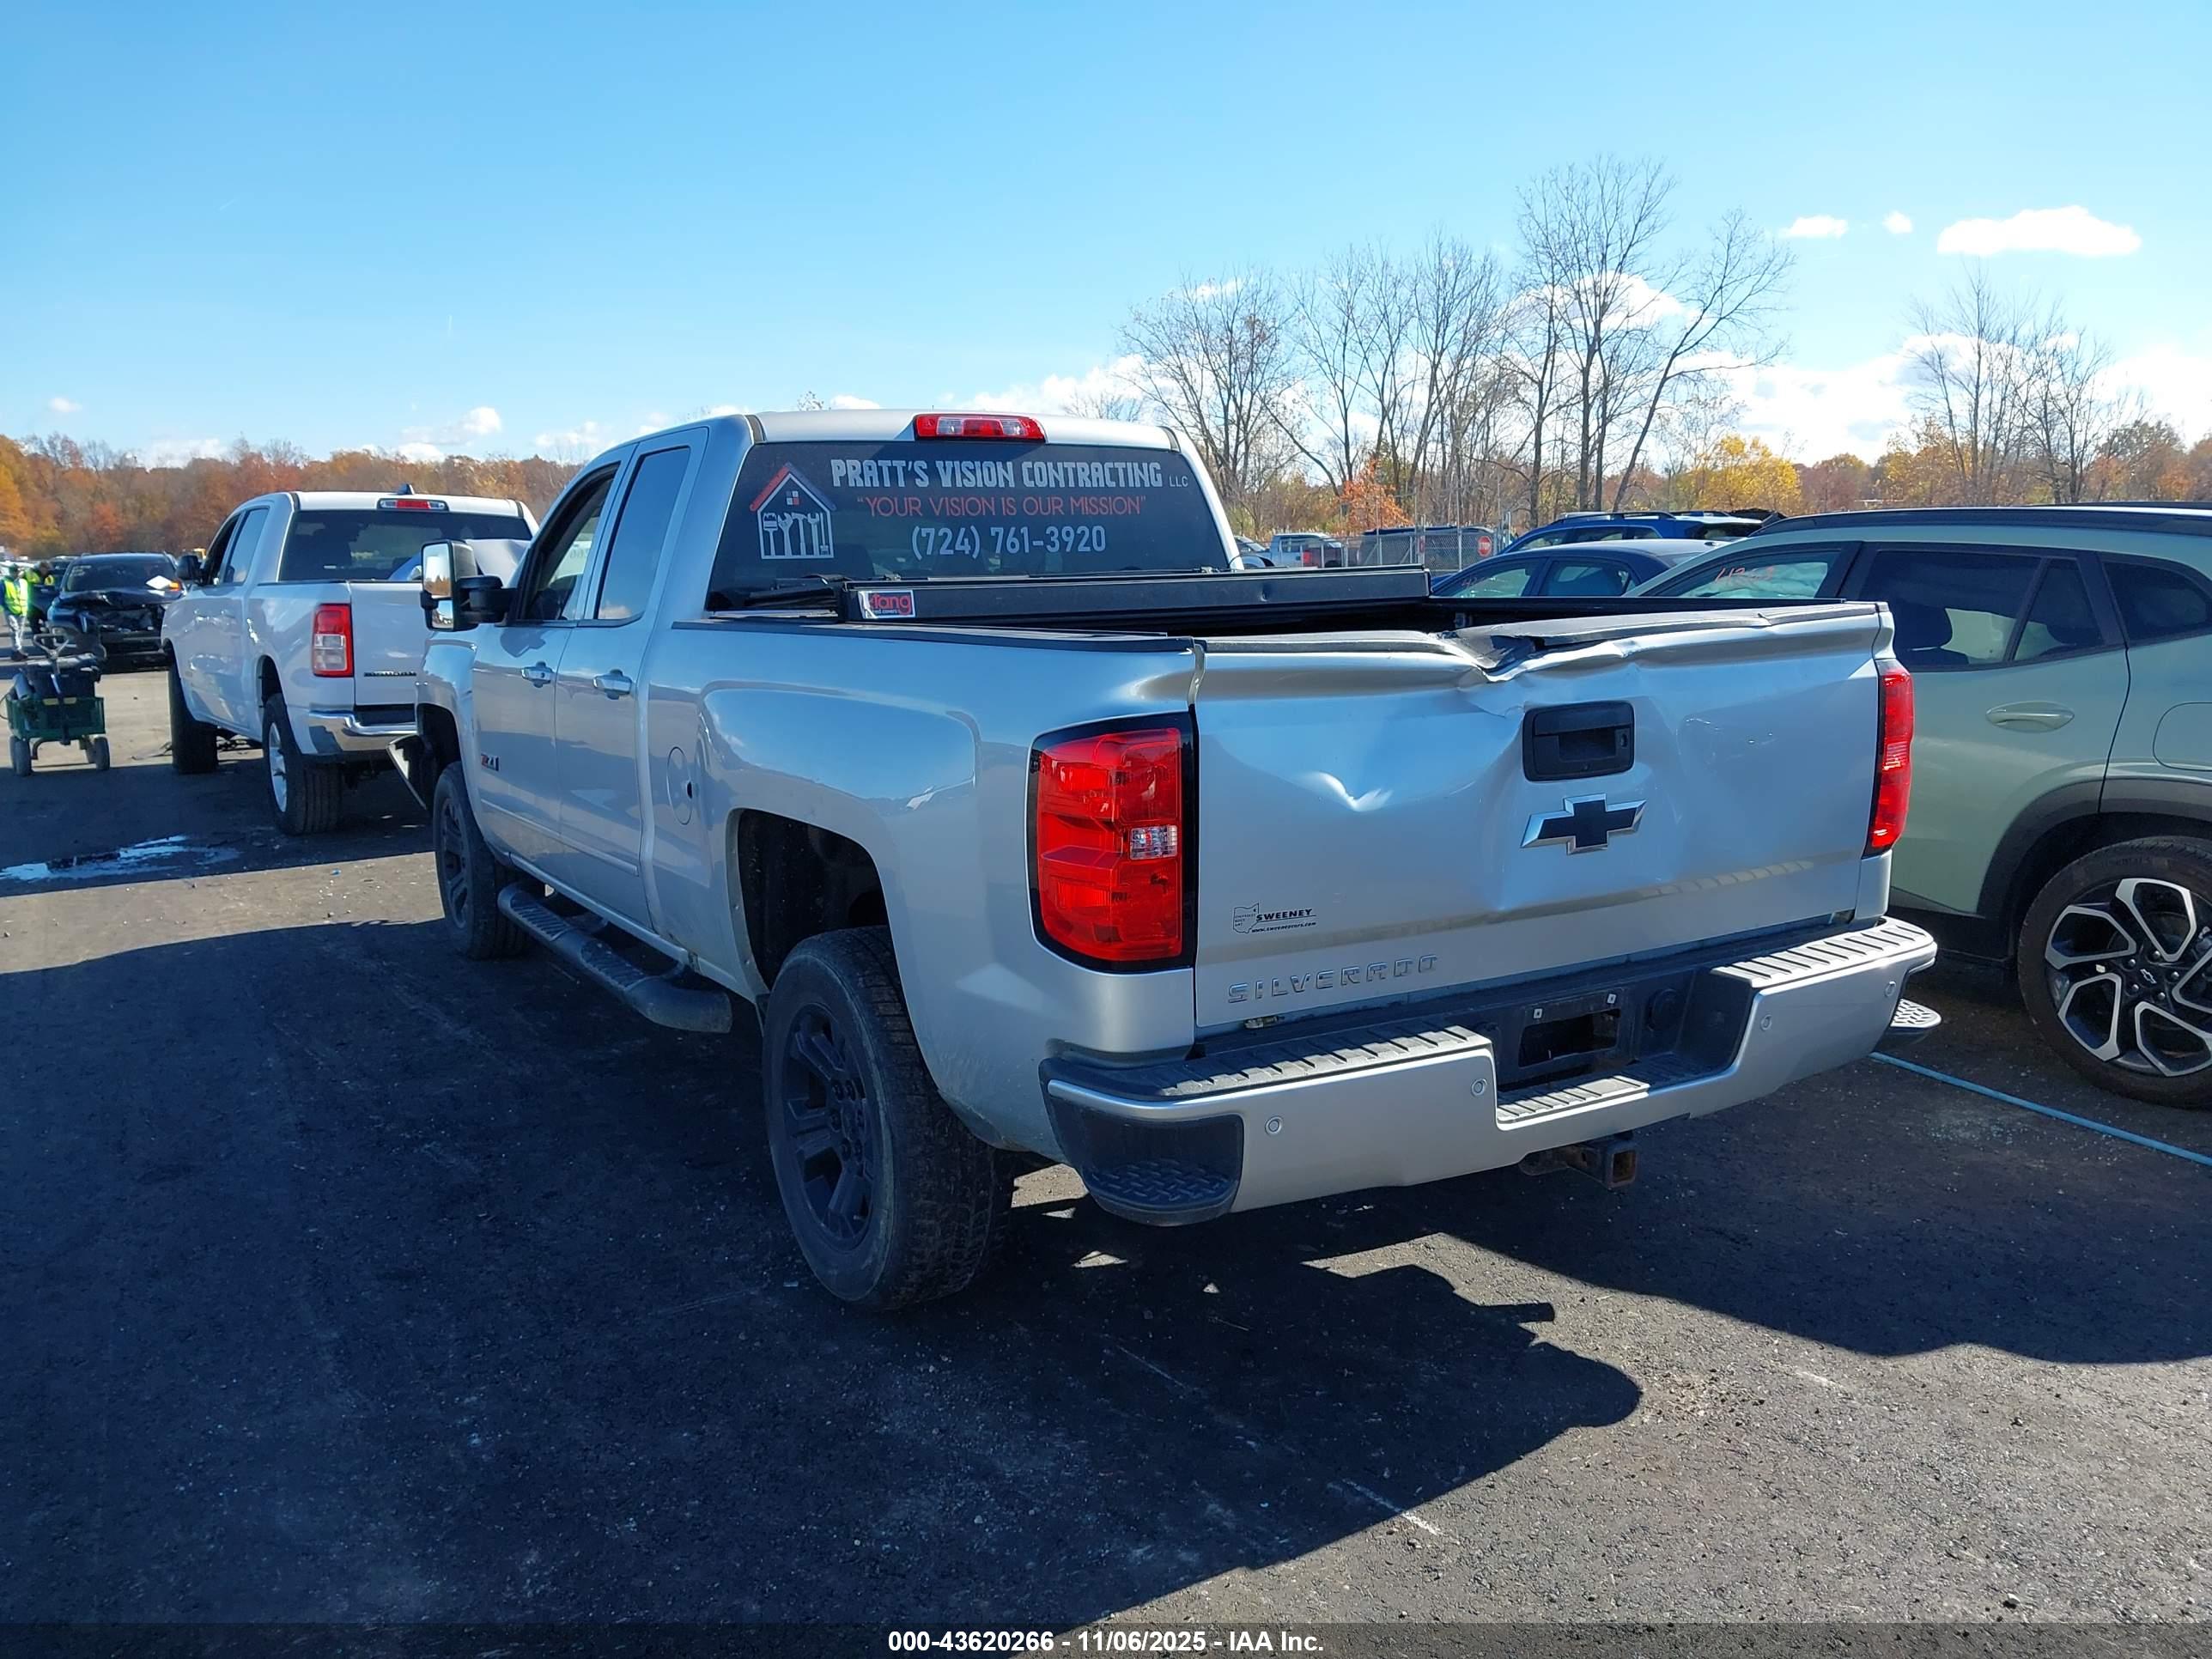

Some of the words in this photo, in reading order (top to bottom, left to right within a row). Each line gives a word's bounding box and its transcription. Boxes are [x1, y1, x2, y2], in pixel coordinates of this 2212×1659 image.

[830, 459, 929, 488] PRATT'S
[935, 460, 1015, 488] VISION
[1021, 461, 1163, 488] CONTRACTING
[1169, 476, 1188, 487] LLC
[928, 497, 996, 516] VISION
[1001, 496, 1017, 515] IS
[1023, 496, 1064, 515] OUR
[912, 526, 981, 560] (724)
[990, 525, 1106, 555] 761-3920
[1255, 908, 1313, 921] SWEENEY
[1228, 955, 1438, 1003] SILVERADO
